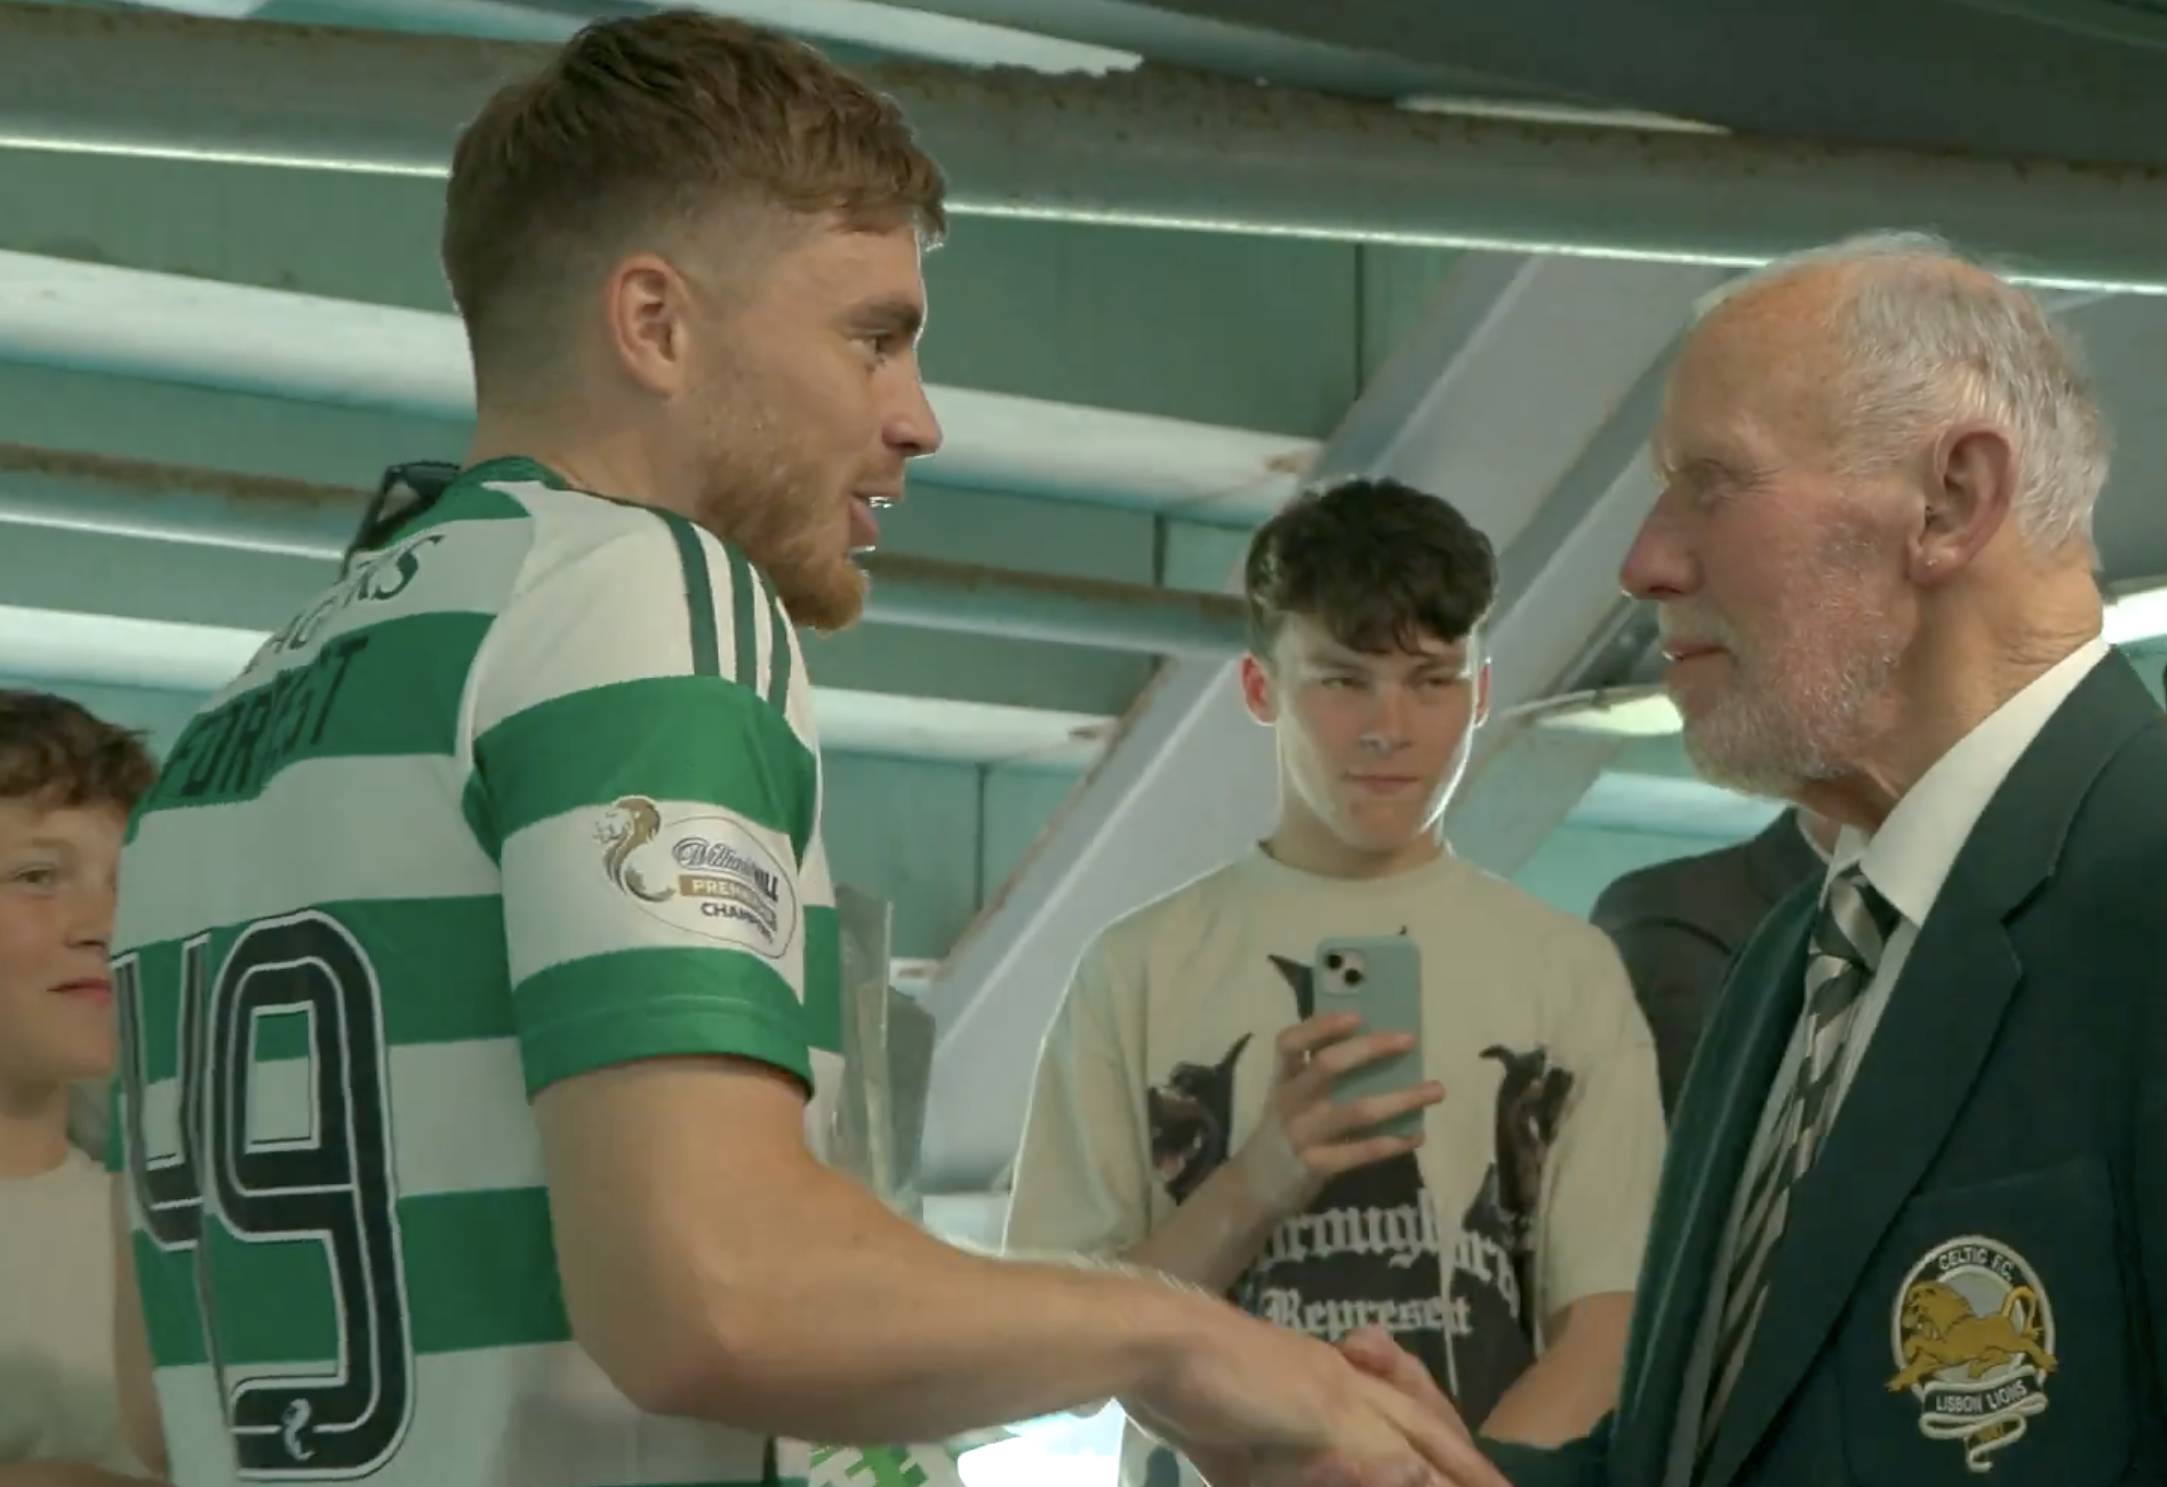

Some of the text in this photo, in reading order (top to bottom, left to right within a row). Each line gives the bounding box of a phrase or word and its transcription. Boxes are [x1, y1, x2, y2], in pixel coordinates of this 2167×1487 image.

[111, 908, 415, 1481] 49
[1938, 1246, 1988, 1271] CELTIC
[1935, 1379, 2027, 1413] LISBON LIONS
